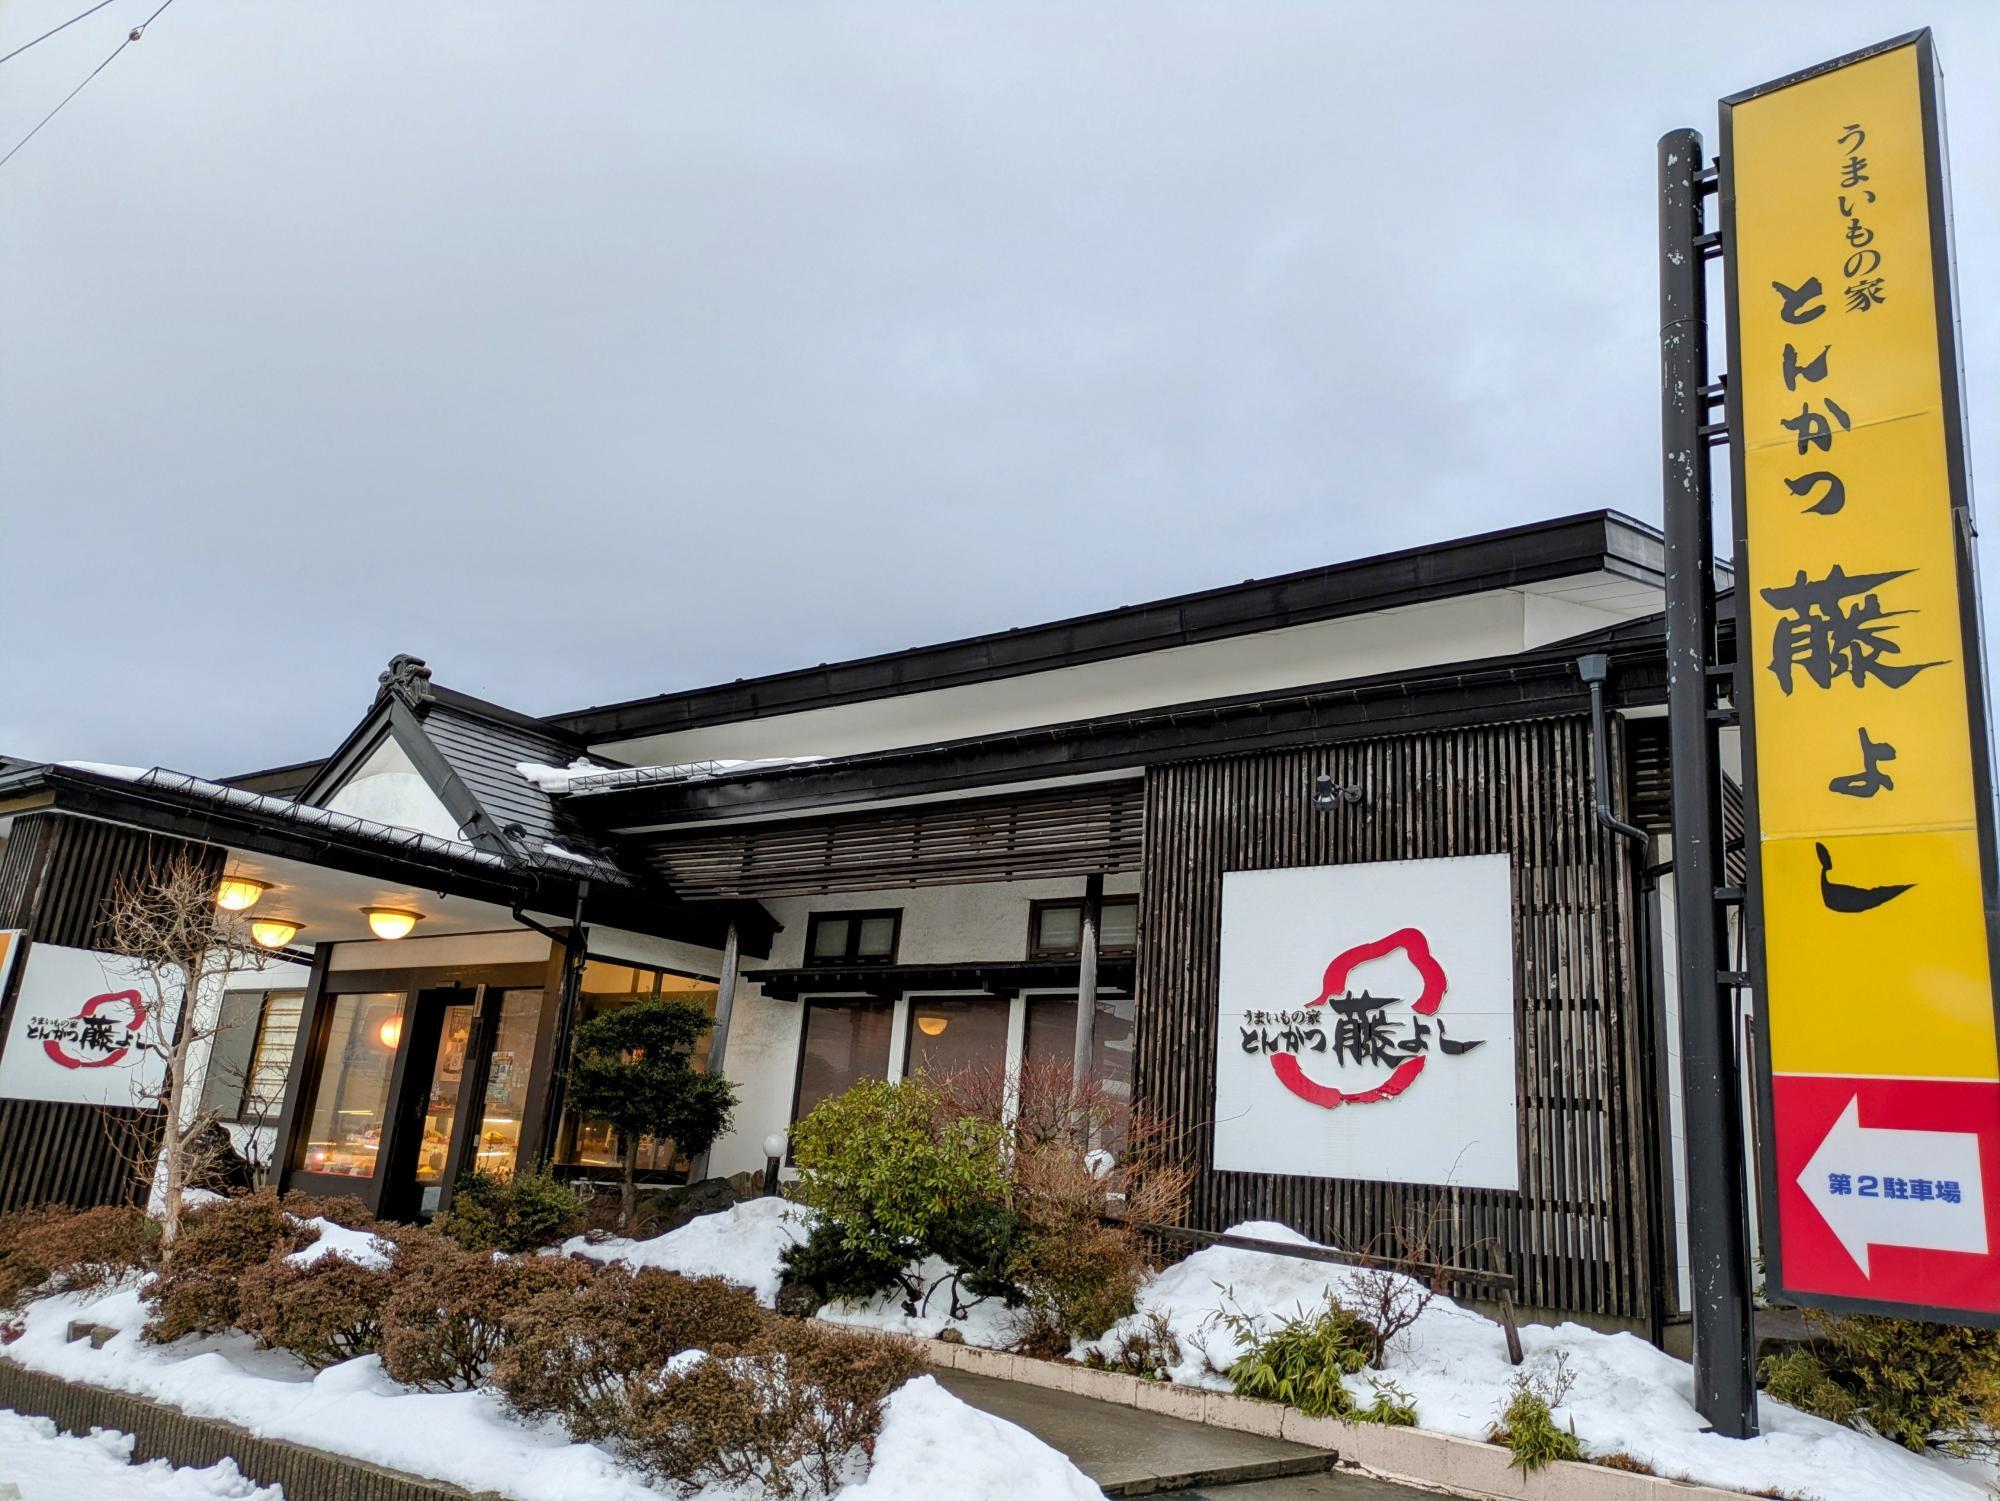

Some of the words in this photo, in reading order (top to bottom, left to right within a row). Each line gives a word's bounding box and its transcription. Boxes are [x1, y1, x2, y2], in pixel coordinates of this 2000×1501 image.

[1837, 123, 1886, 313] うまいもの家
[1243, 1009, 1322, 1026] うまいもの家
[1828, 1173, 1961, 1204] 第2駐車場
